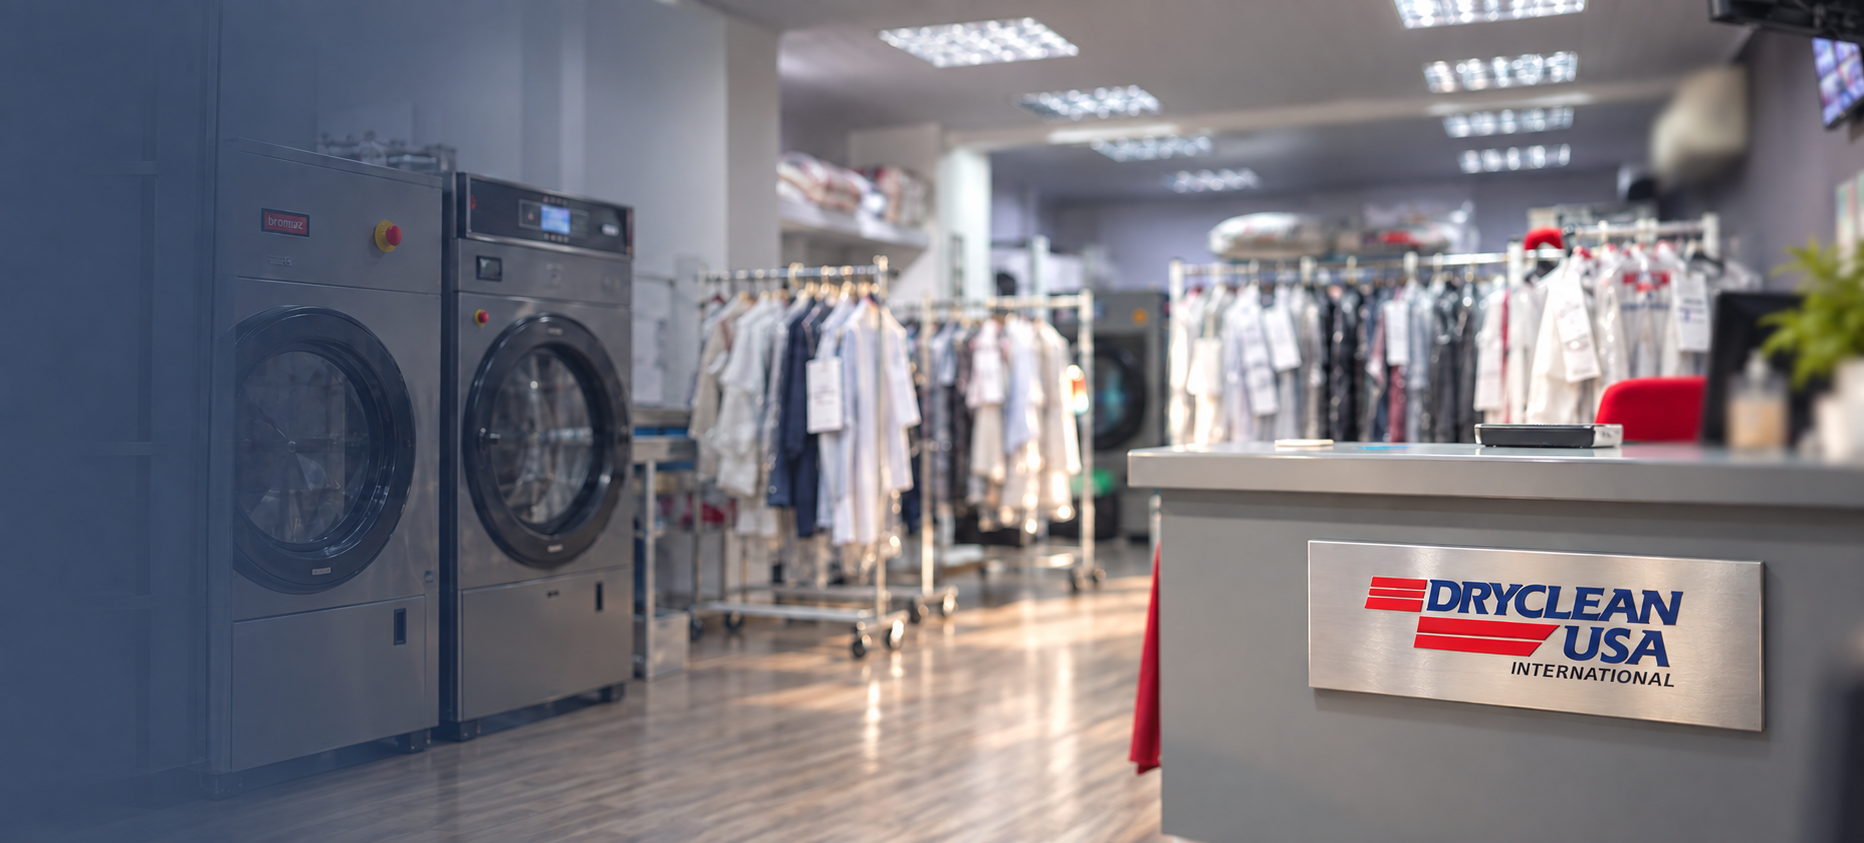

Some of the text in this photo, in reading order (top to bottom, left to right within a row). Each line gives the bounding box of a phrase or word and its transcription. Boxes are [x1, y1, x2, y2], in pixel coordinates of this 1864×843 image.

[1426, 579, 1683, 625] DRYCLEAN
[1563, 625, 1671, 667] USA
[1511, 661, 1675, 687] INTERNATIONAL
